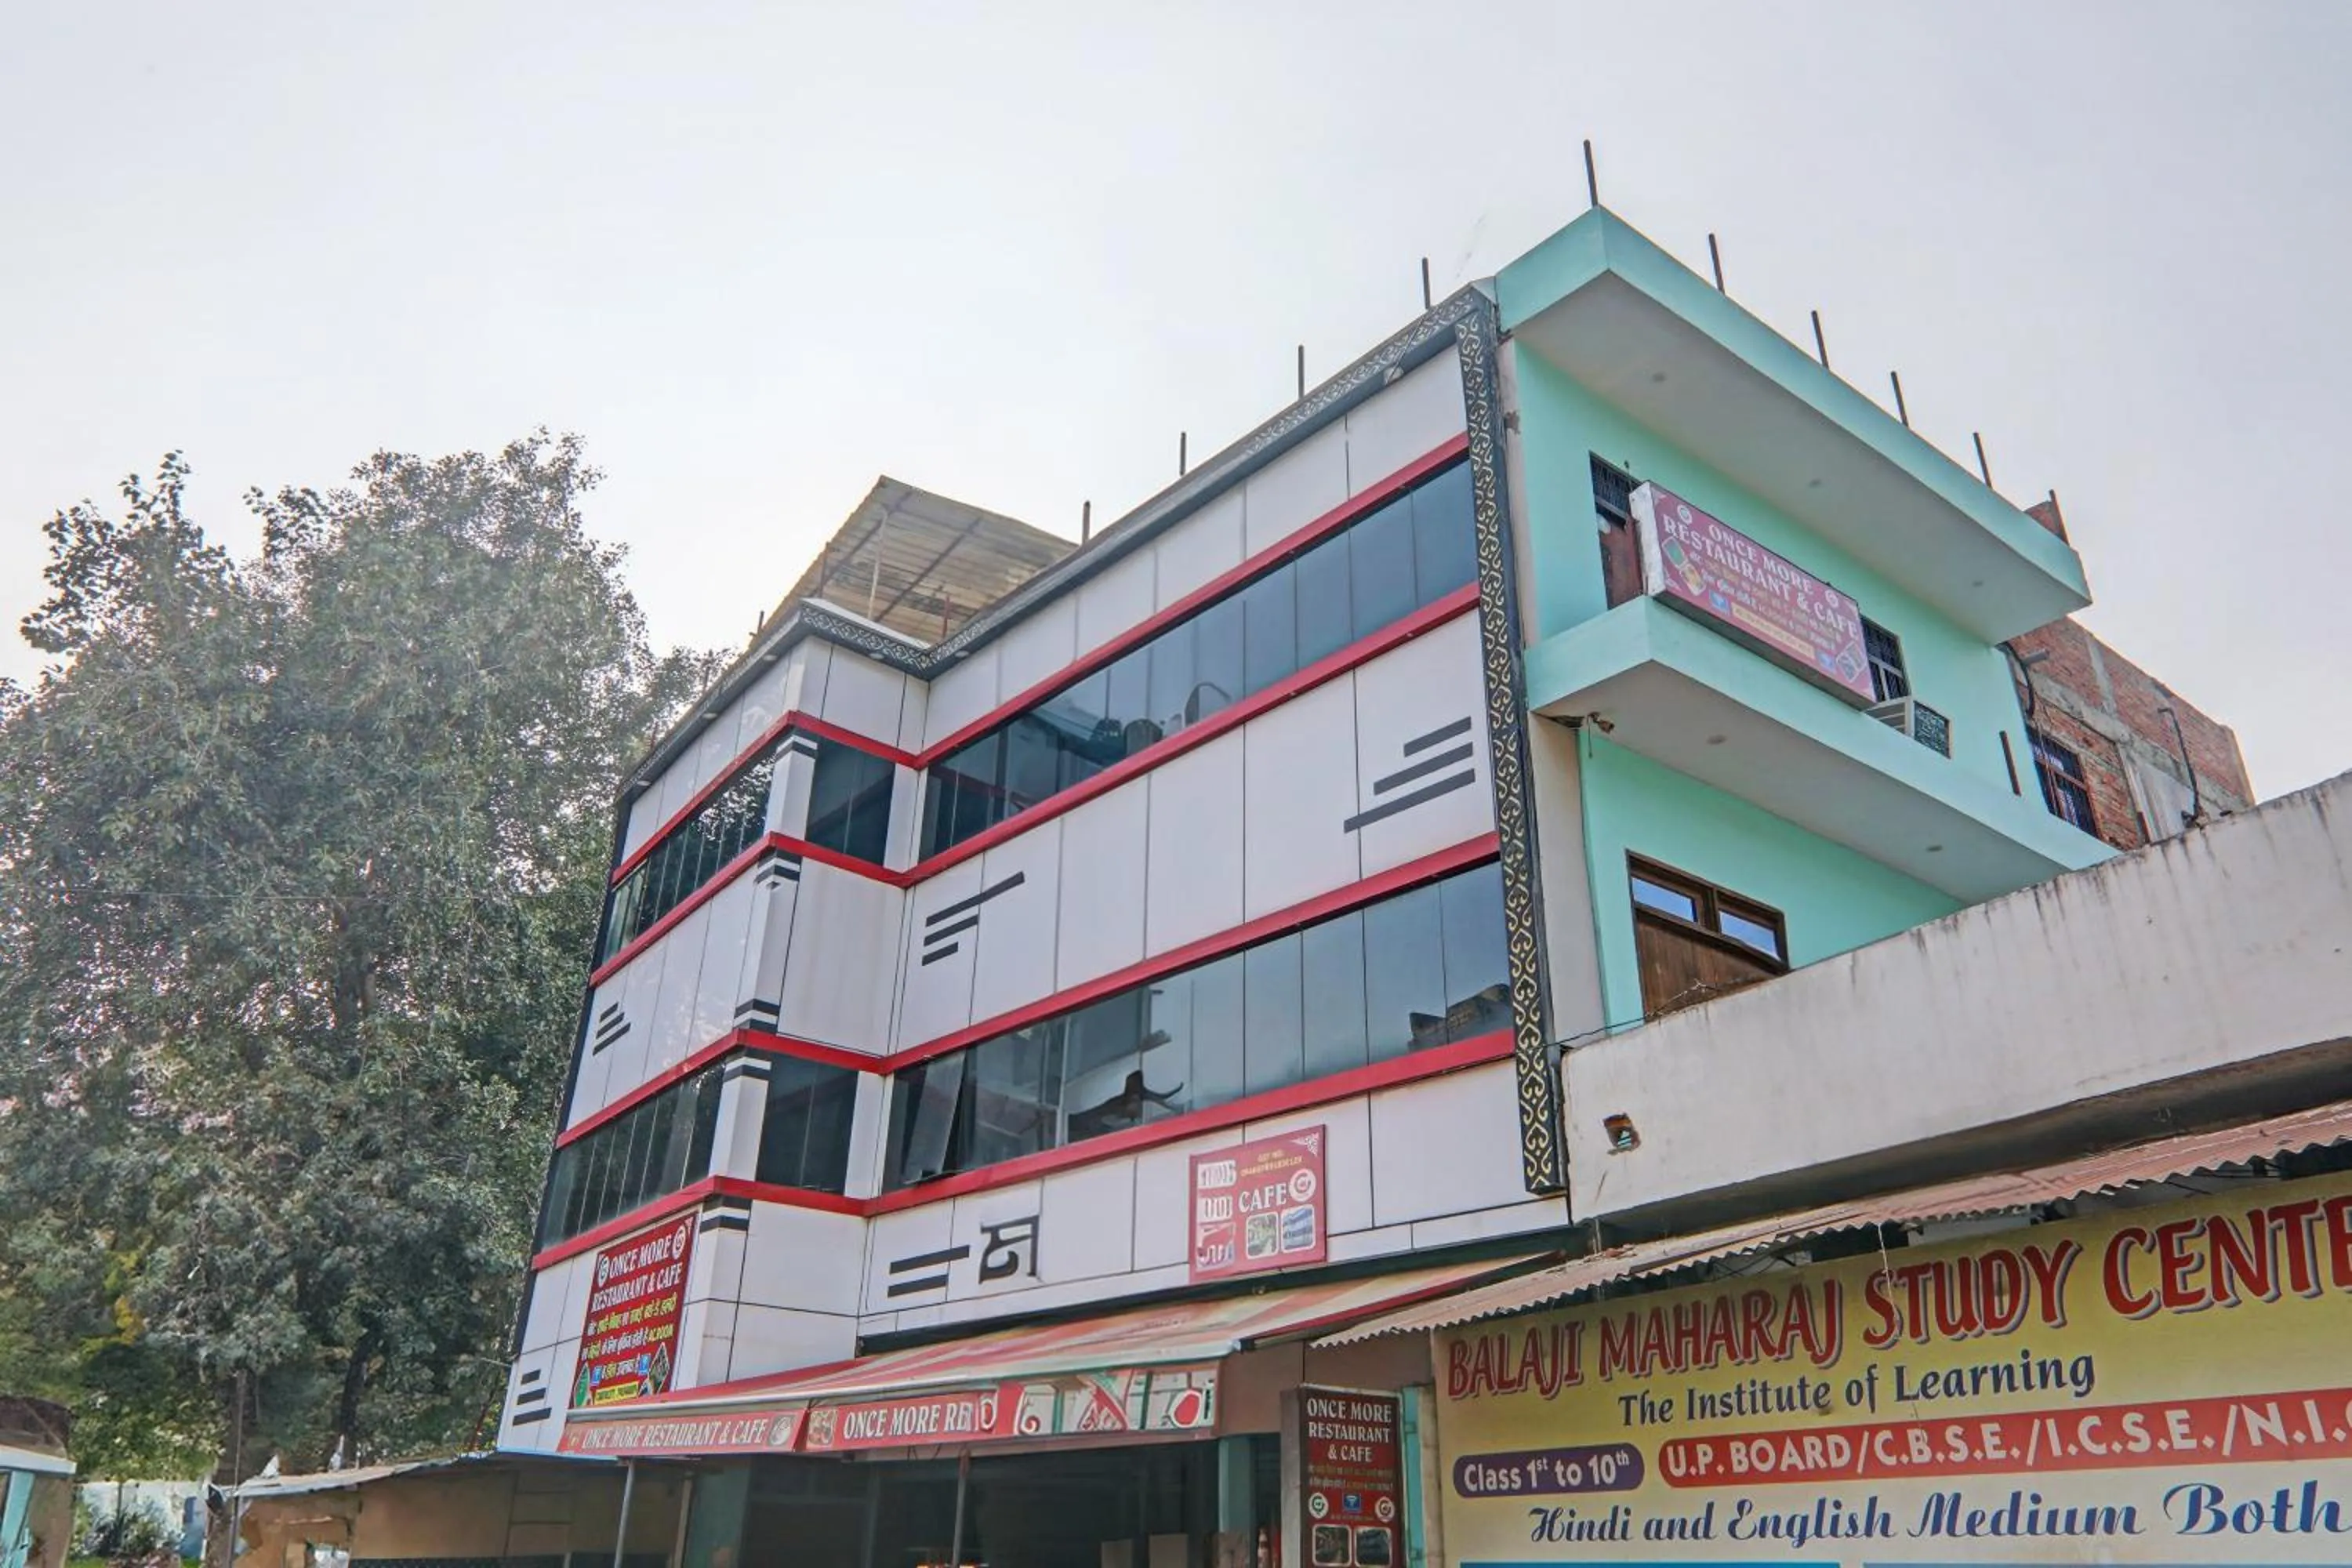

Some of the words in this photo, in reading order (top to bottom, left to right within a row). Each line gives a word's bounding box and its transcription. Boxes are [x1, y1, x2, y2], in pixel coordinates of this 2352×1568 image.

[1663, 514, 1791, 601] RESTAURANT
[1797, 592, 1809, 612] &
[1814, 601, 1858, 639] CAFE
[1708, 524, 1759, 563] ONCE
[1763, 555, 1813, 594] MORE
[1239, 1182, 1287, 1213] CAFE
[609, 1248, 637, 1279] ONCE
[637, 1234, 673, 1269] MORE
[591, 1274, 648, 1313] RESTAURANT
[648, 1271, 656, 1293] &
[656, 1262, 683, 1290] CAFE
[1447, 1321, 1585, 1399] BALAJI
[1599, 1279, 1843, 1382] MAHARAJ
[1862, 1240, 2082, 1348] STUDY
[1618, 1390, 1673, 1427] The
[1687, 1374, 1831, 1421] Institute
[1846, 1364, 1879, 1415] of
[1894, 1348, 2096, 1403] Learning
[844, 1402, 888, 1441] ONCE
[890, 1399, 942, 1437] MORE
[1307, 1398, 1346, 1419] ONCE
[1350, 1402, 1392, 1423] MORE
[1308, 1421, 1391, 1443] RESTAURANT
[581, 1427, 612, 1450] ONCE
[610, 1425, 644, 1450] MORE
[641, 1420, 720, 1447] RESTAURANT
[720, 1419, 731, 1444] &
[731, 1417, 769, 1445] CAFE
[1327, 1443, 1337, 1460] &
[1341, 1446, 1373, 1463] CAFE
[1731, 1399, 2352, 1475] BOARD/C.B.S.E./I.C.S.E./N.I.
[1464, 1463, 1522, 1492] Class
[1526, 1457, 1548, 1489] 1st
[1555, 1464, 1582, 1488] to
[1588, 1449, 1631, 1486] 10th
[1529, 1504, 1633, 1544] Hindi
[1643, 1501, 1717, 1541] and
[1727, 1495, 1896, 1548] English
[1907, 1491, 2146, 1538] Medium
[2164, 1479, 2352, 1537] Both
